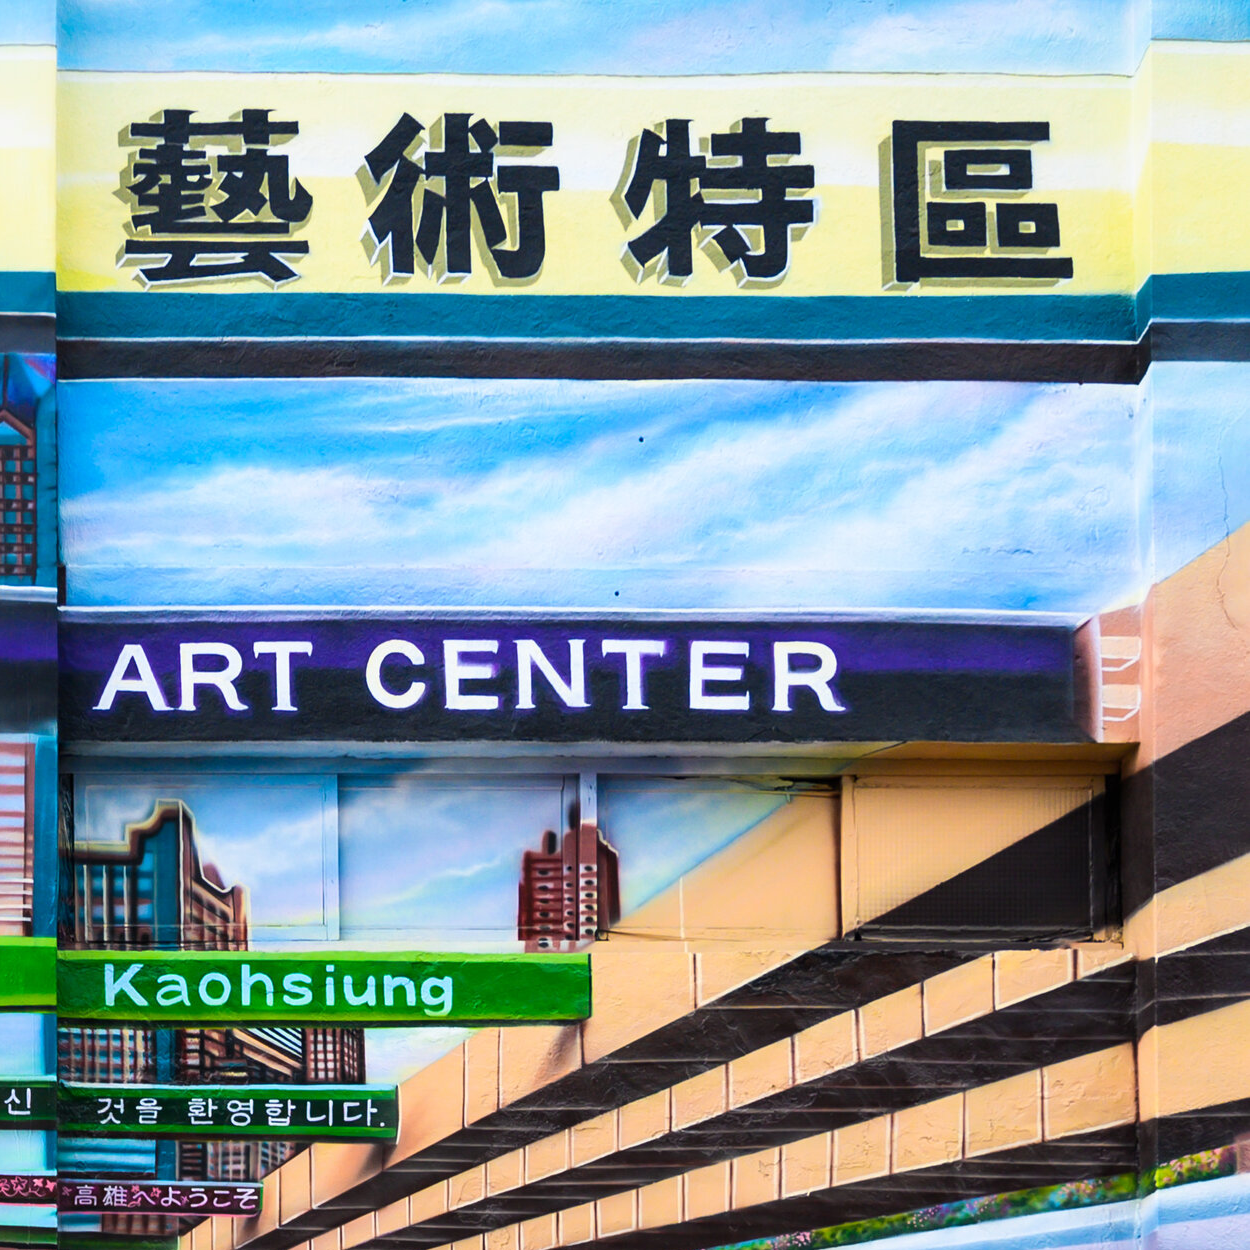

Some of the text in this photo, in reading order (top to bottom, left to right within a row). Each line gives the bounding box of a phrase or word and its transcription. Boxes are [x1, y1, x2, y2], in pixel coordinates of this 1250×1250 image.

[92, 640, 313, 711] ART
[364, 638, 846, 712] CENTER
[104, 963, 454, 1018] Kaohsiung
[97, 1097, 163, 1125] 것을
[74, 1184, 258, 1209] 高雄へようこそ
